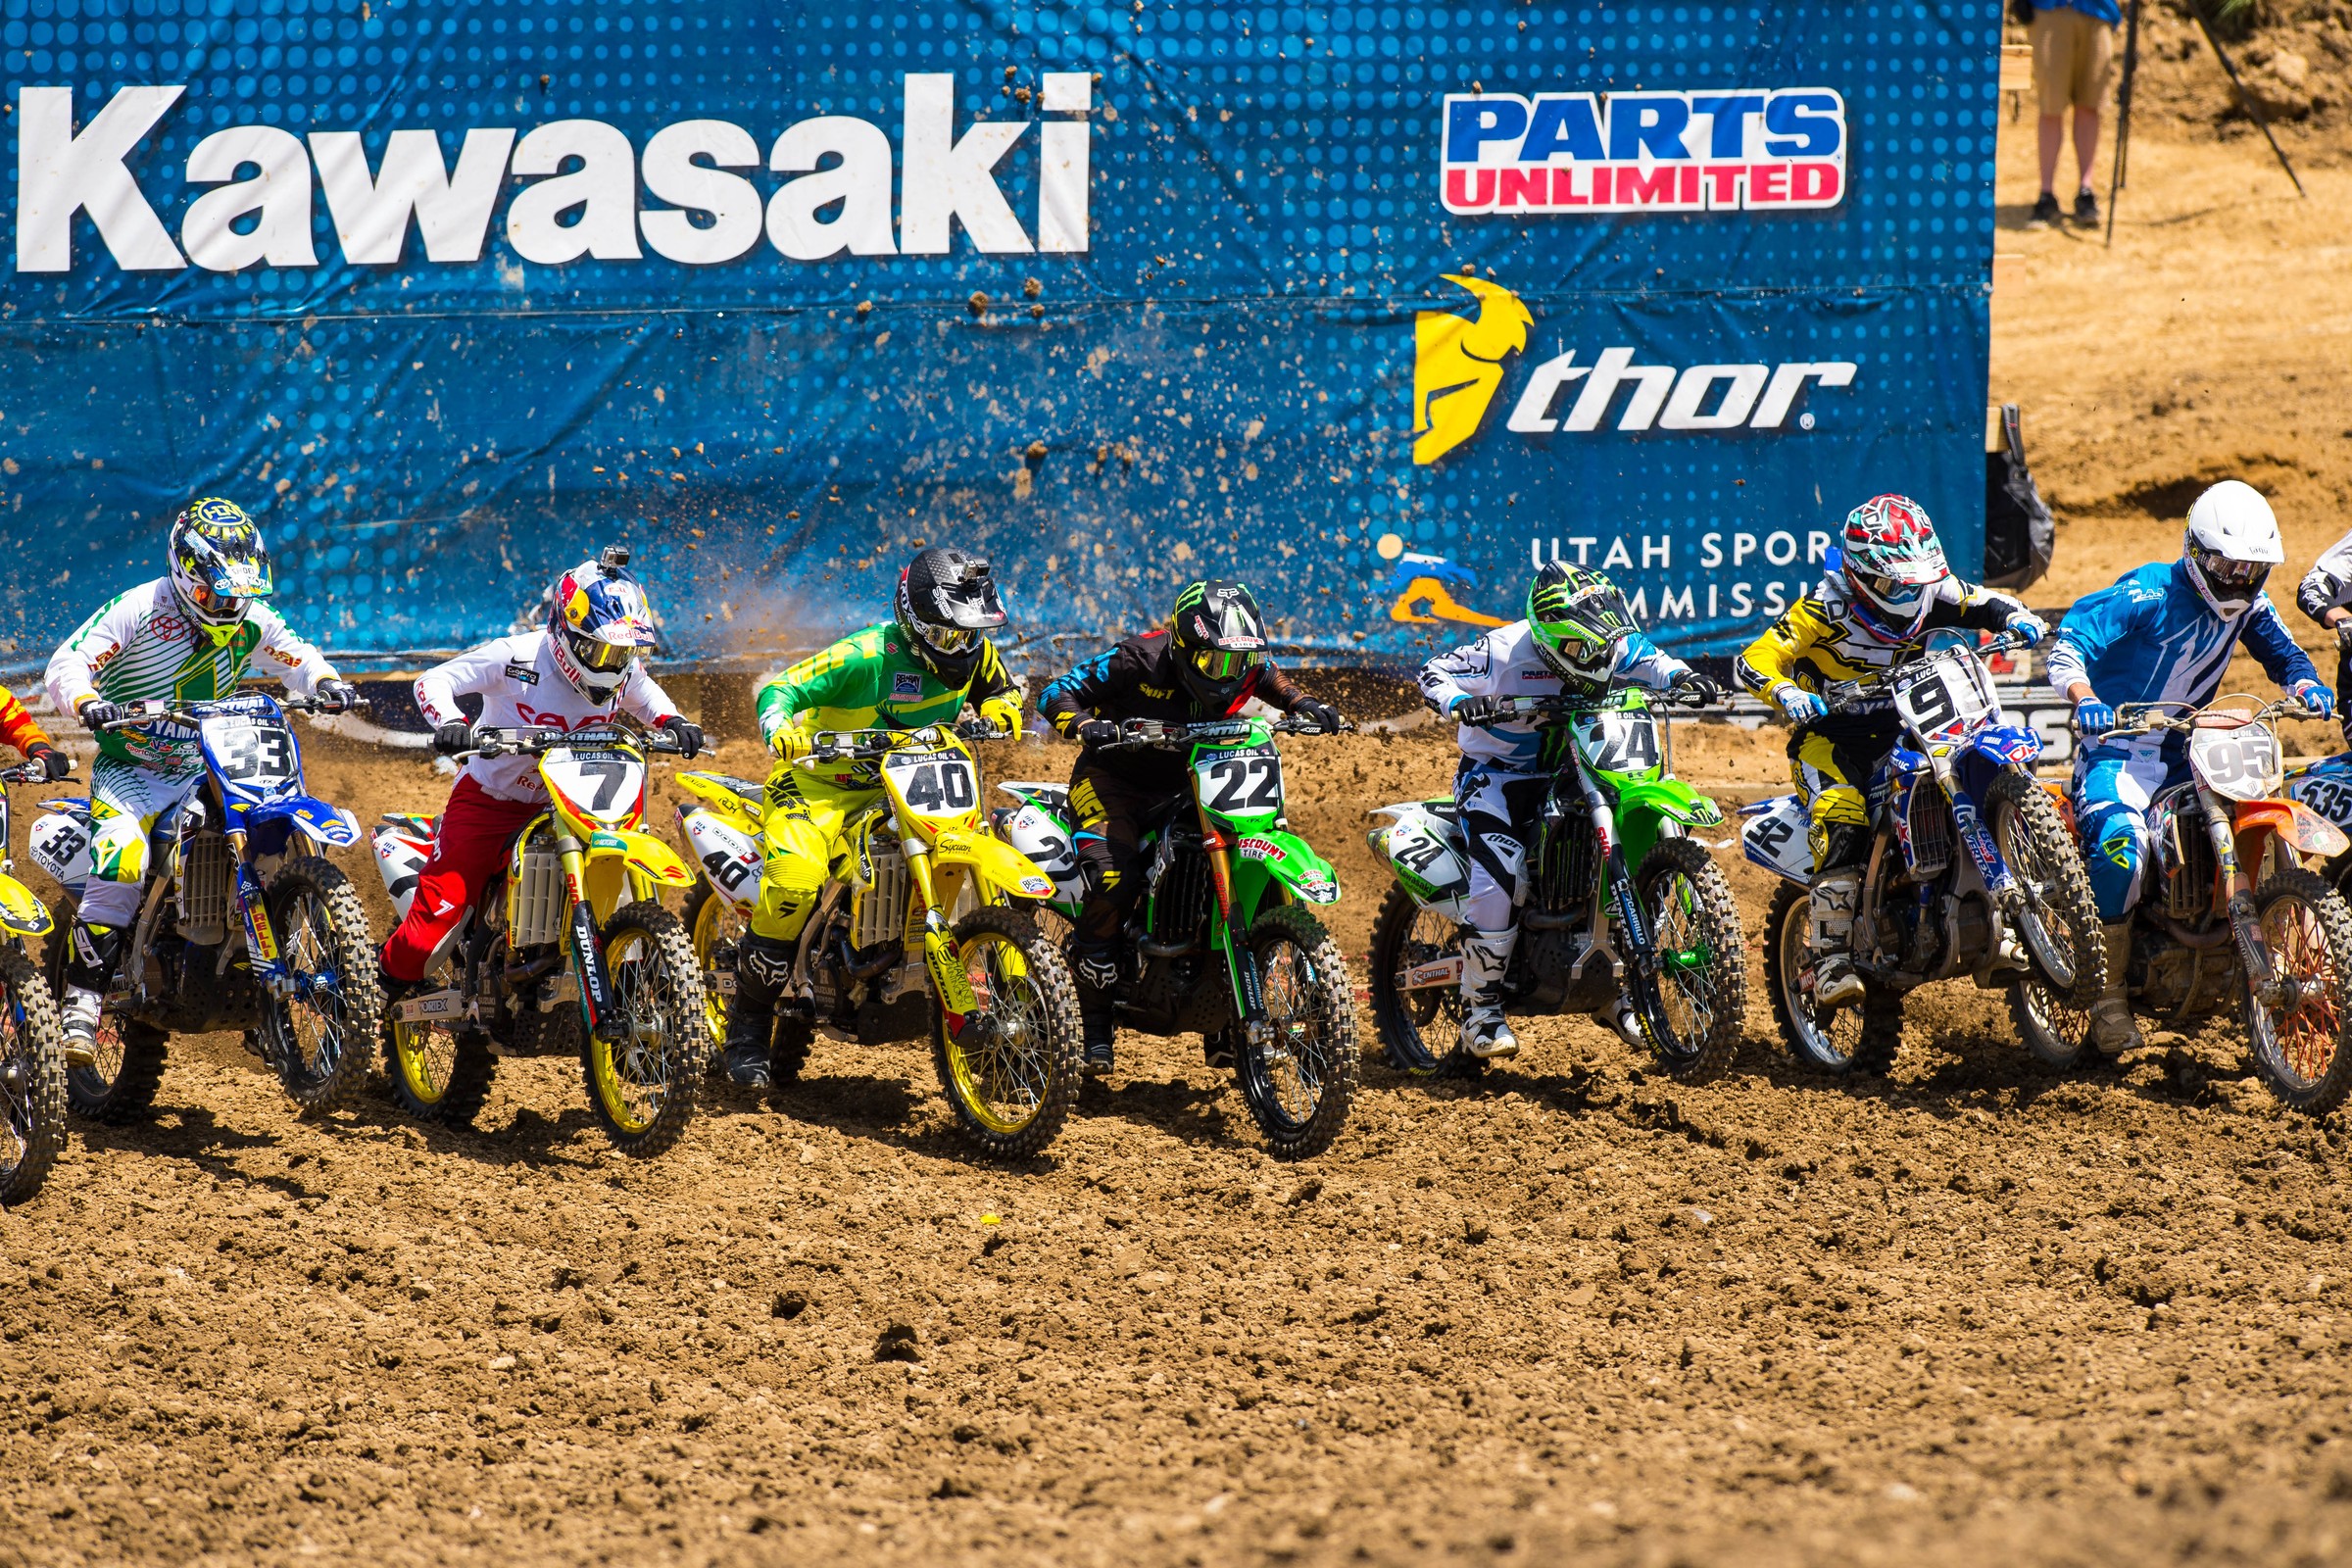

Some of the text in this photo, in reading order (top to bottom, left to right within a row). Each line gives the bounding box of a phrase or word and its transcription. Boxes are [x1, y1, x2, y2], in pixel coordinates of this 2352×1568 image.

[1446, 94, 1841, 163] PARTS
[17, 72, 1091, 273] Kawasaki
[1446, 163, 1839, 208] UNLIMITED
[1506, 347, 1857, 432] thor
[1531, 530, 1842, 571] UTAH SPOR
[1618, 581, 1809, 619] MMISSI
[609, 628, 656, 644] Red Bull
[1218, 635, 1265, 646] DISCOUNT
[554, 646, 581, 686] Bull
[1915, 666, 1938, 682] LUCA
[1139, 682, 1175, 701] SHIFT
[257, 718, 270, 727] OIL
[2240, 729, 2254, 738] OIL
[223, 729, 291, 780] 33
[574, 752, 614, 761] LUCAS OIL
[913, 752, 949, 762] LUCAS OIL
[1218, 748, 1259, 760] LUCAS OIL
[1589, 721, 1659, 771] 24
[2206, 740, 2274, 784] 95
[579, 762, 627, 811] 7
[906, 762, 974, 812] 40
[1208, 758, 1280, 812] 22
[2300, 780, 2352, 826] 535
[39, 825, 87, 867] 33
[939, 838, 972, 855] Sycuan
[1243, 849, 1264, 860] TIRE
[1394, 836, 1446, 874] 24
[1487, 834, 1523, 850] thor
[1745, 815, 1794, 859] 92
[1964, 834, 1995, 879] VERTEX
[36, 852, 65, 881] TOYOTA
[702, 851, 751, 892] 40
[1396, 864, 1433, 894] Kawasaki
[566, 872, 580, 910] SHO
[249, 904, 272, 958] IRELLI
[1610, 883, 1634, 951] DUNLOP
[1627, 899, 1646, 946] CARRILLO
[575, 924, 603, 1003] DUNLOP
[927, 951, 954, 1009] DUNLOP
[417, 998, 449, 1015] VORTEX
[1244, 970, 1256, 1010] DUNLOP
